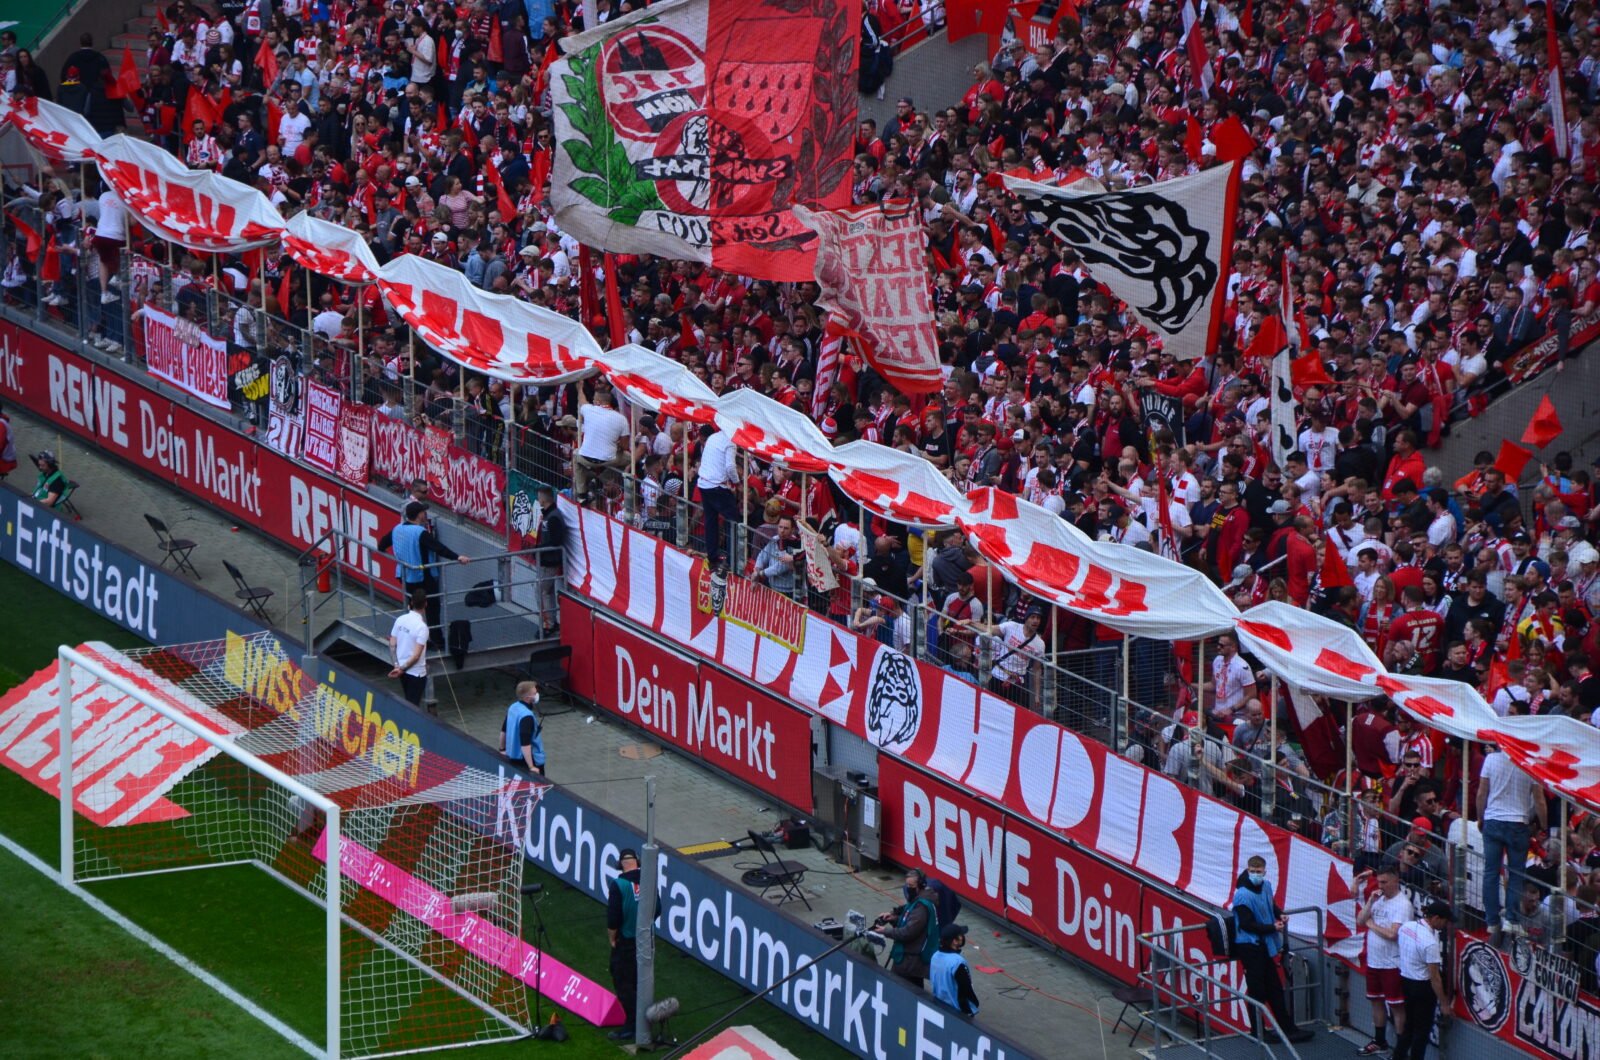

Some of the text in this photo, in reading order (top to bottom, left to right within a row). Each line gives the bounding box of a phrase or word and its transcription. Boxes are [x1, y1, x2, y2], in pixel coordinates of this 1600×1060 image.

[48, 353, 129, 449] REWE
[139, 398, 189, 479] Dein
[195, 429, 262, 518] Markt
[15, 500, 159, 640] Erftstadt
[289, 474, 381, 579] REWE
[614, 644, 777, 780] Dein Markt
[1411, 625, 1438, 650] 12
[557, 493, 858, 727] WILDE
[926, 673, 1367, 970] HORDE
[496, 765, 889, 1060] Küchefachmarkt
[902, 780, 1033, 917] REWE
[1055, 857, 1135, 969] Dein
[1149, 905, 1258, 1031] Mark
